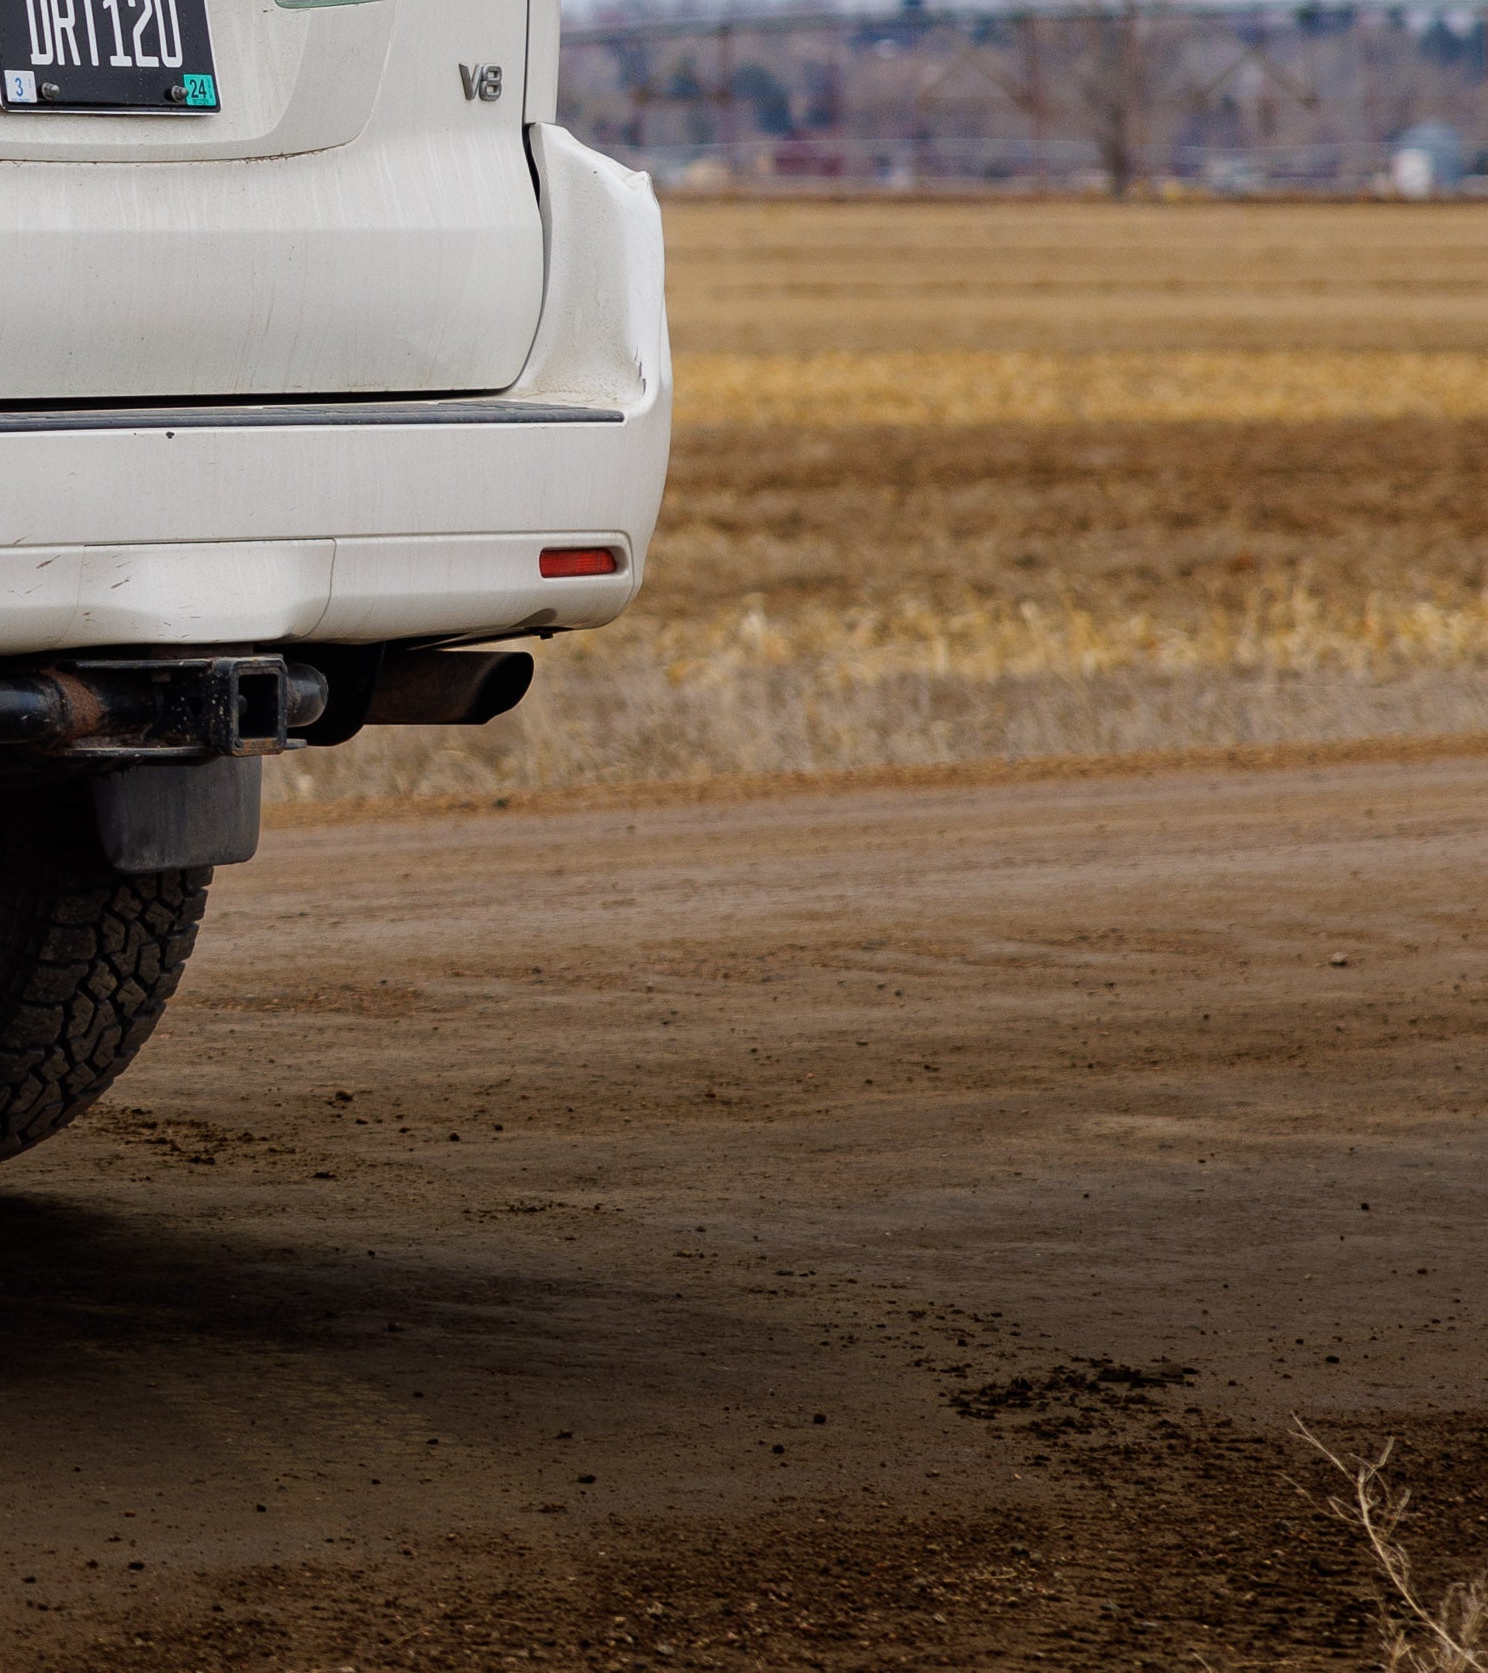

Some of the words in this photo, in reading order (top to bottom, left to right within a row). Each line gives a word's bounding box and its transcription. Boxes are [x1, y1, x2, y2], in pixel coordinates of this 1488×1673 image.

[15, 77, 24, 97] 3
[190, 79, 207, 99] 24
[458, 62, 502, 101] V8
